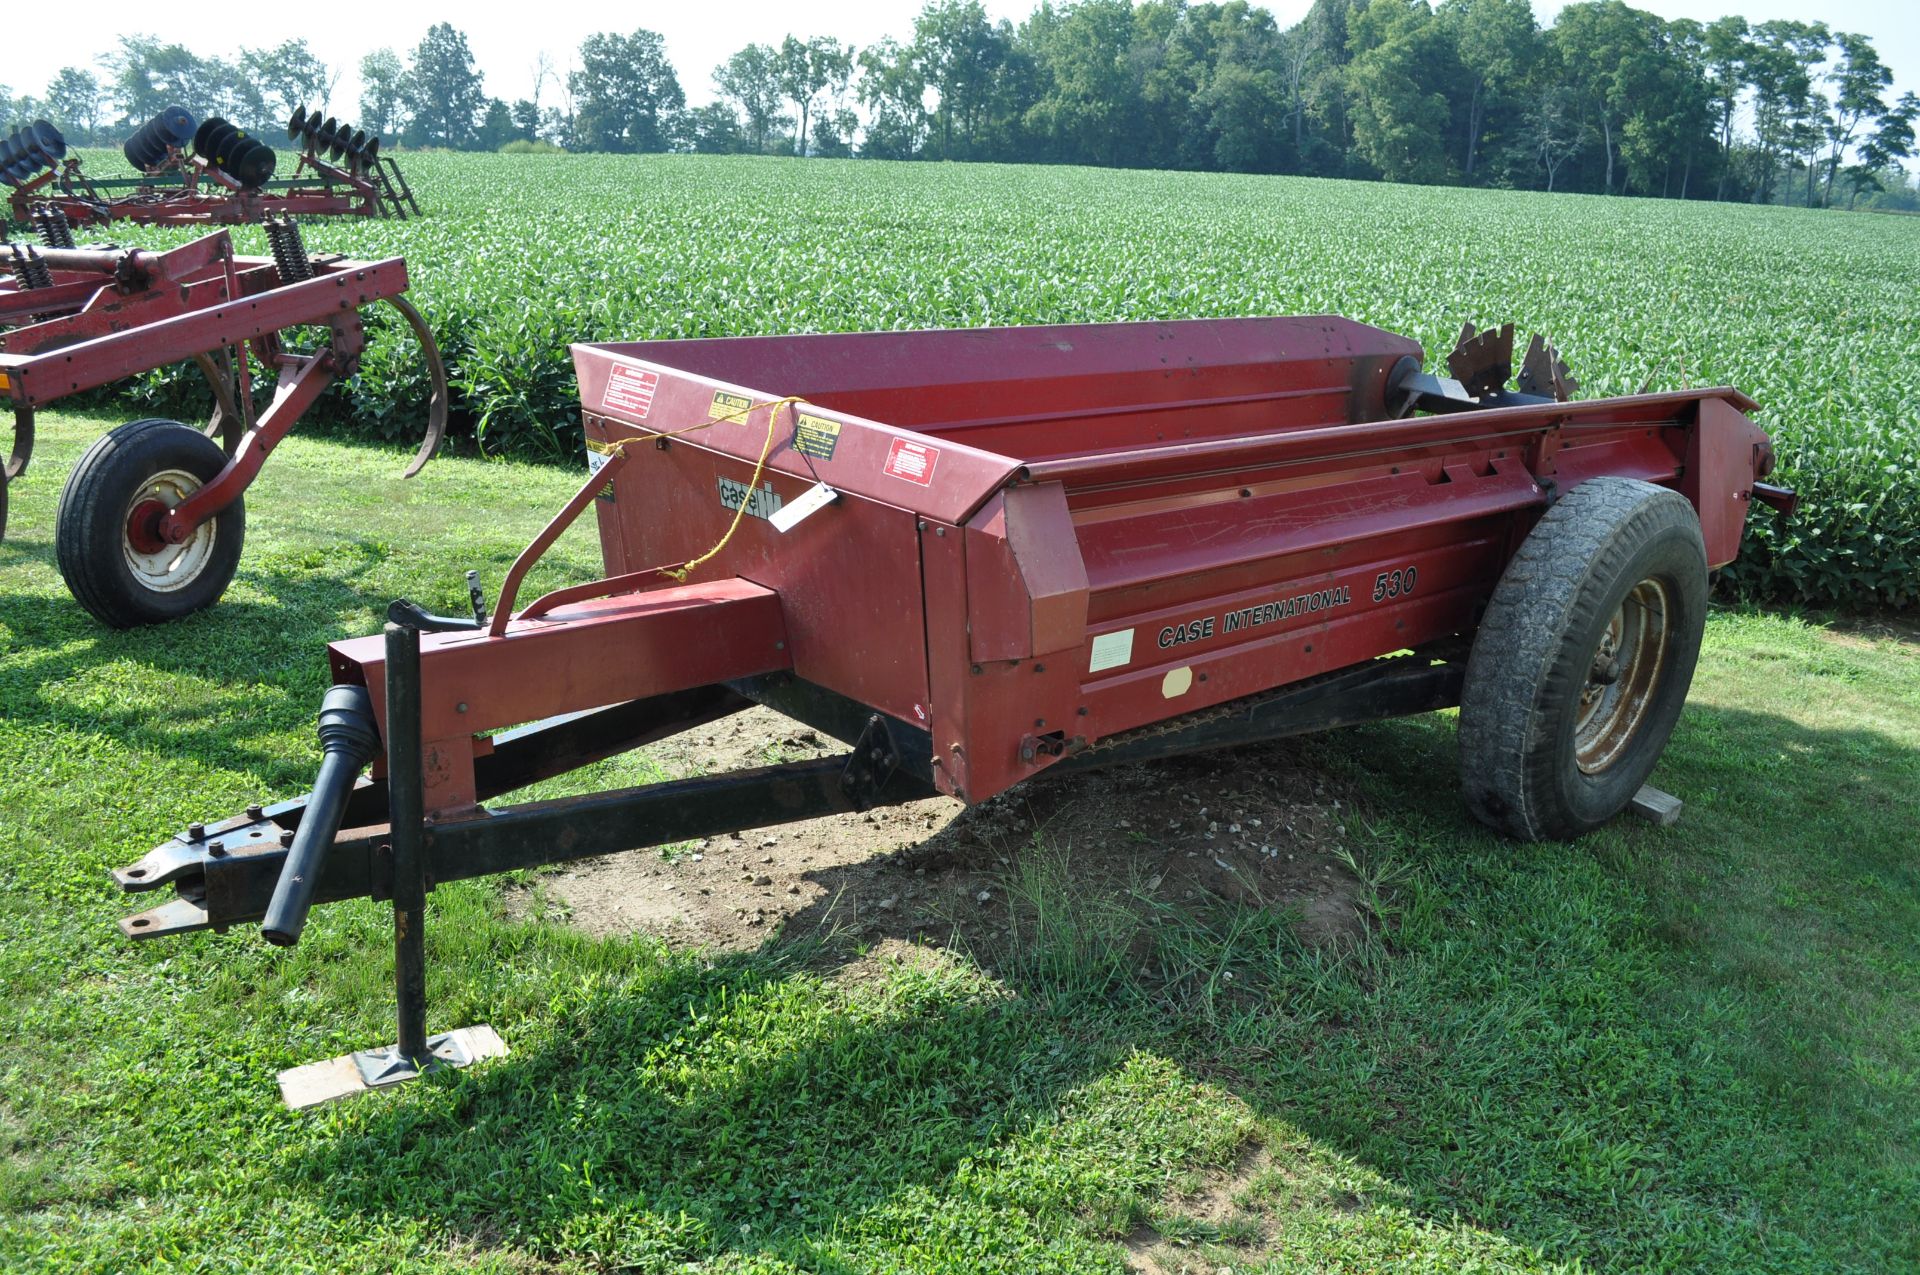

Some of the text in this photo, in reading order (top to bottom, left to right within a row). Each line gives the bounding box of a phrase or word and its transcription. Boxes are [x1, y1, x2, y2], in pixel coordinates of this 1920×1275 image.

[725, 395, 749, 408] CAUTION
[810, 420, 834, 433] CAUTION
[1158, 566, 1417, 649] CASE INTERNATIONAL 530
